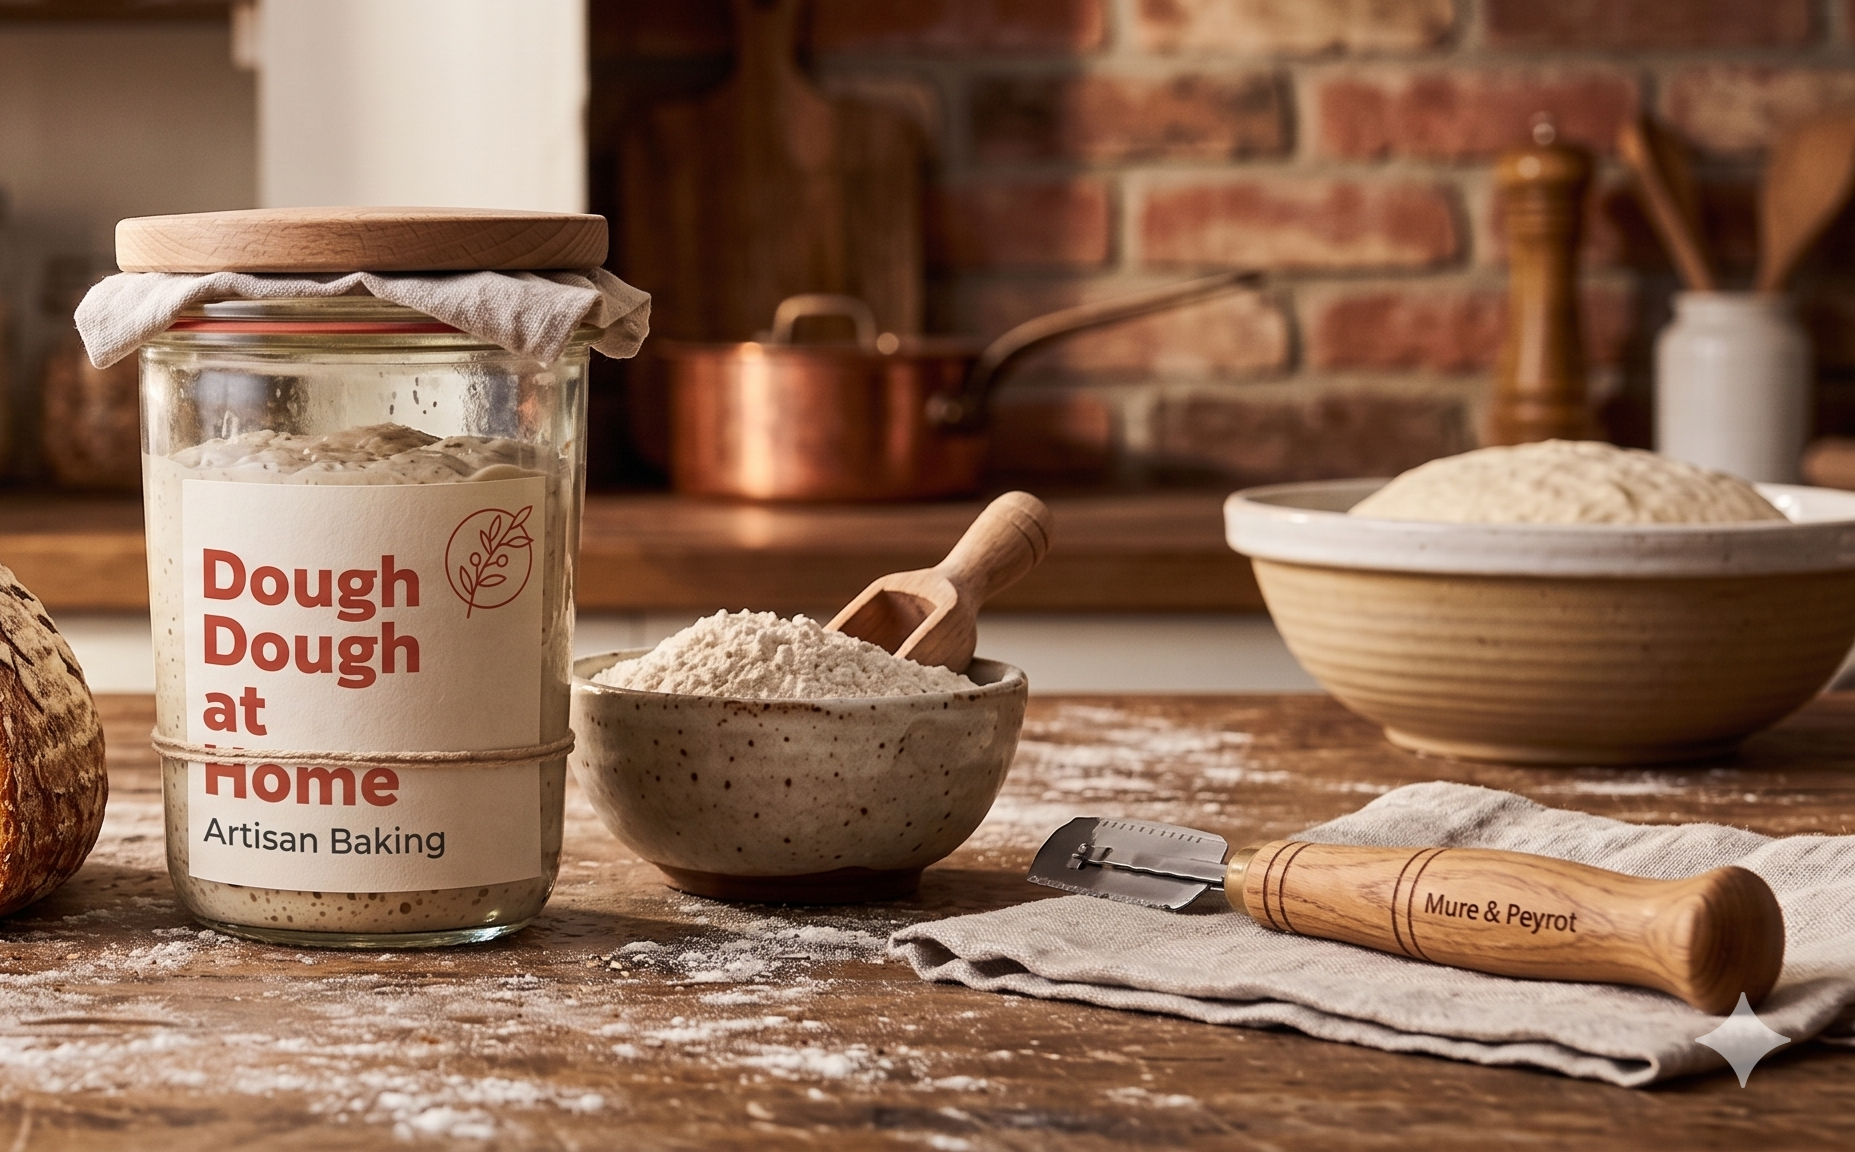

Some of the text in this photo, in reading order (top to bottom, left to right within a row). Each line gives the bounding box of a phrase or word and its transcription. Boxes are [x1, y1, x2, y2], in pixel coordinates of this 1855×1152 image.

[203, 548, 420, 622] Dough
[203, 614, 420, 689] Dough
[202, 687, 267, 736] at
[205, 744, 399, 806] Home
[203, 817, 446, 860] Artisan Baking
[1424, 892, 1579, 935] Mure & Peyrot
